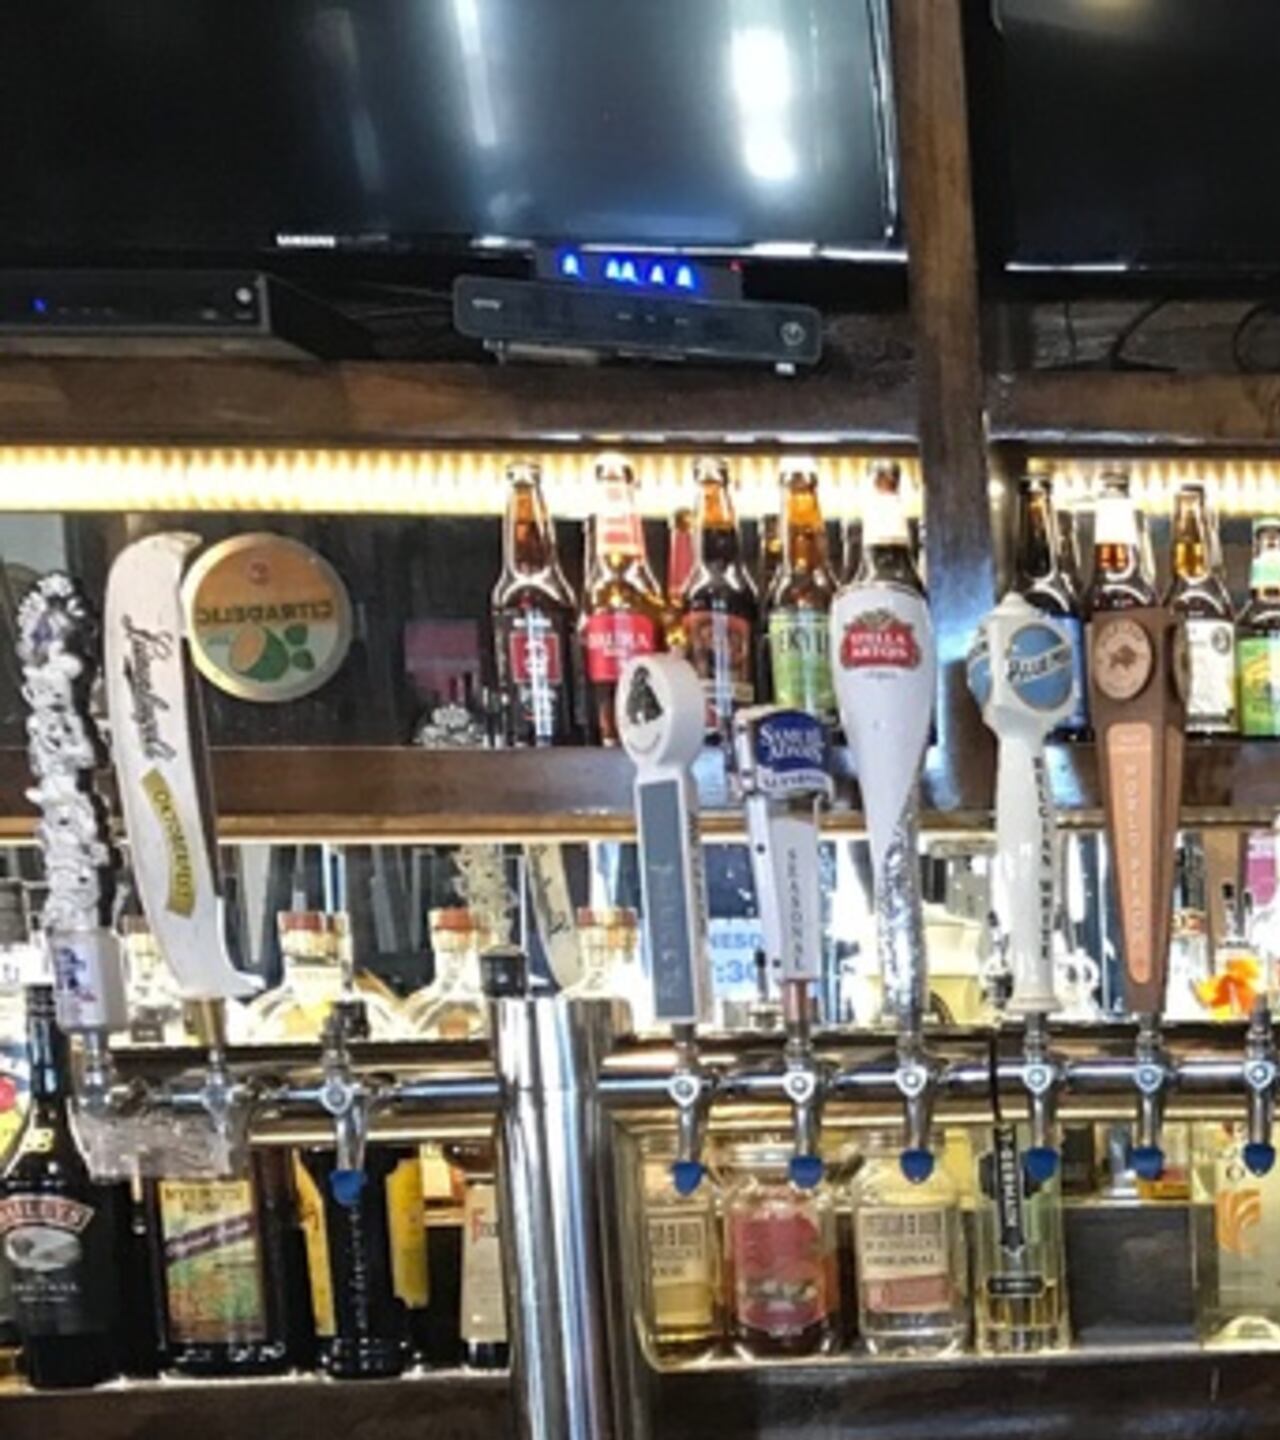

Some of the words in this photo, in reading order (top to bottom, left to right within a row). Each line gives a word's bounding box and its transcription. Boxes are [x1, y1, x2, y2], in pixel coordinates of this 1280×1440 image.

[849, 632, 908, 645] STELLA
[850, 645, 909, 659] ARTOIS
[759, 722, 823, 744] SAMUEL
[764, 739, 827, 764] ADAMS
[787, 848, 805, 972] SEASONAL
[0, 1200, 80, 1230] AILEYS
